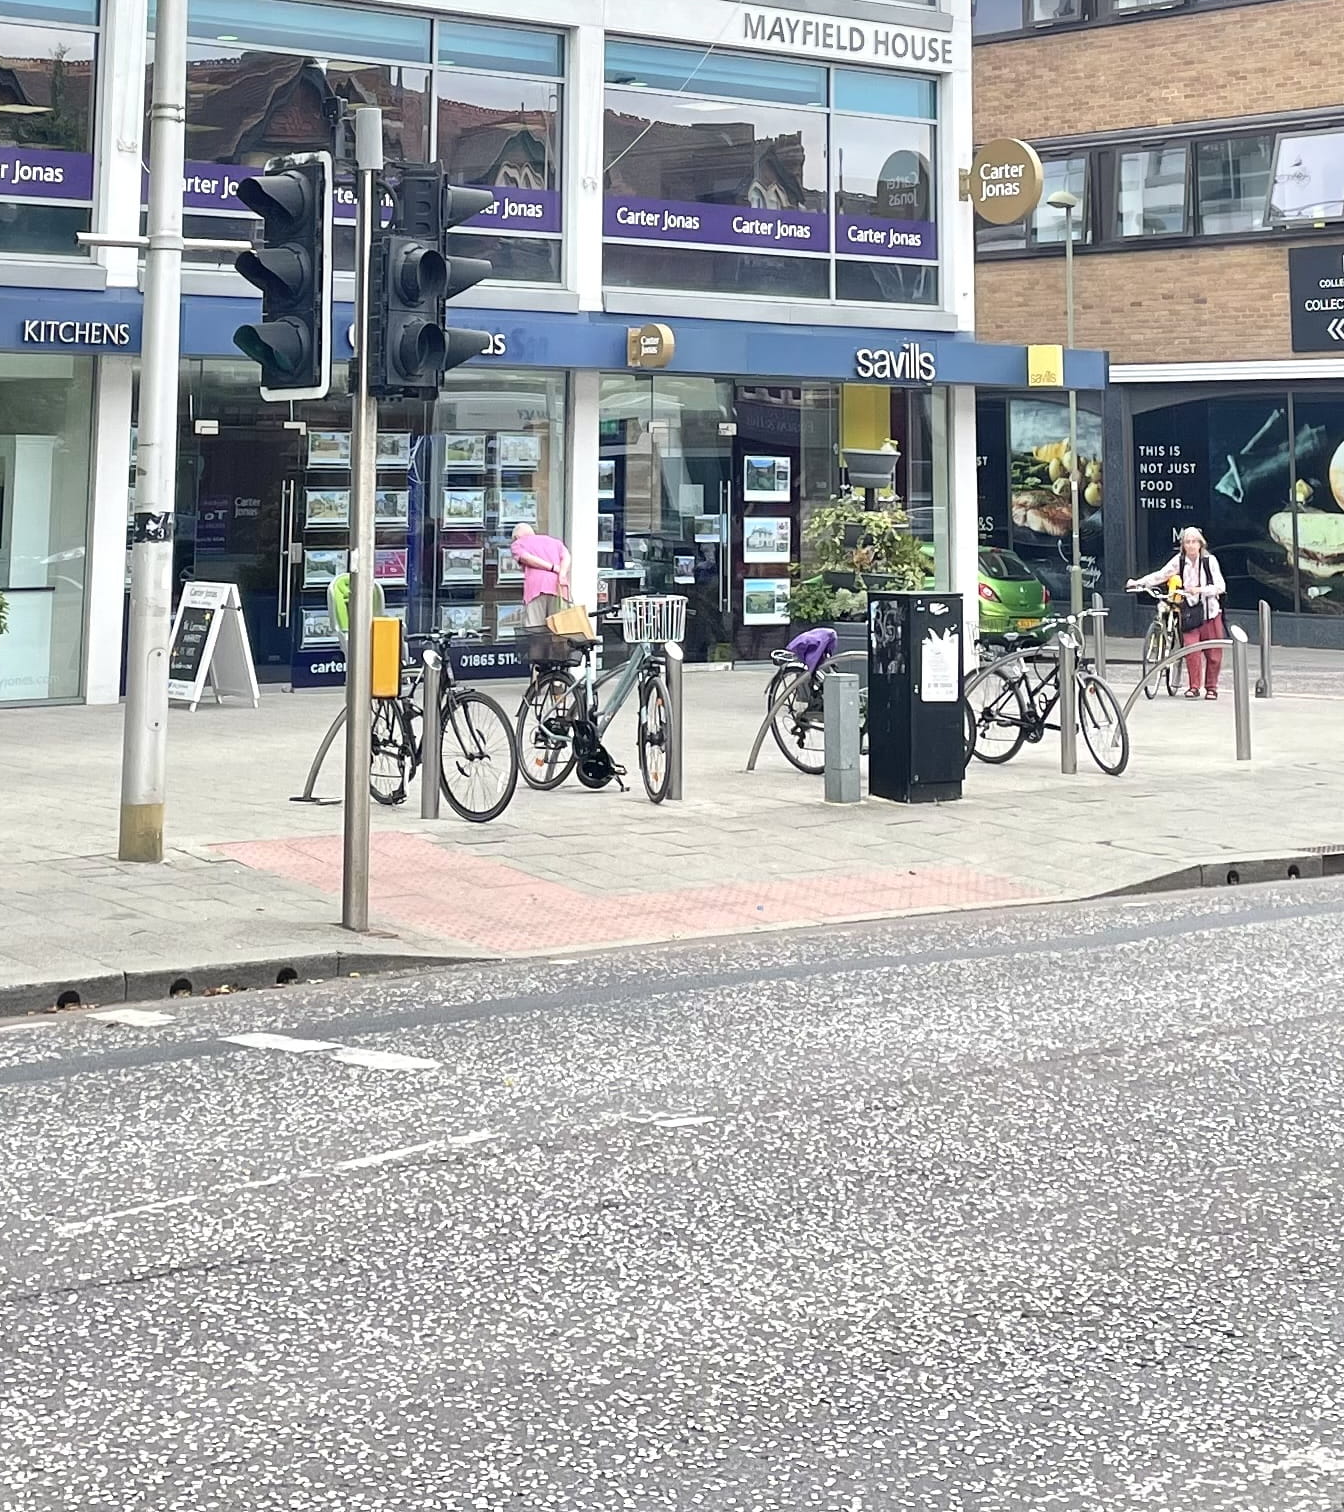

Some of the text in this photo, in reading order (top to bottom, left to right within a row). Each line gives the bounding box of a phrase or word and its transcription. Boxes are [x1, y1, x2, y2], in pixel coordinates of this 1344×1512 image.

[744, 12, 953, 64] MAYFIELD HOUSE
[11, 159, 64, 184] Jonas
[980, 163, 1025, 181] Carter
[182, 176, 219, 196] arter
[980, 180, 1020, 201] Jonas
[502, 196, 543, 219] Jonas
[616, 207, 700, 231] Carter Jonas
[732, 216, 811, 239] Carter Jonas
[847, 225, 922, 248] Carter Jonas
[23, 319, 131, 346] KITCHENS
[856, 342, 936, 382] savills
[1030, 370, 1057, 384] savills
[1138, 445, 1181, 457] THIS IS
[1139, 463, 1196, 474] NOT JUST
[1140, 480, 1173, 491] FOOD
[1140, 498, 1167, 509] THIS
[978, 516, 994, 532] &S
[460, 653, 496, 668] 01865
